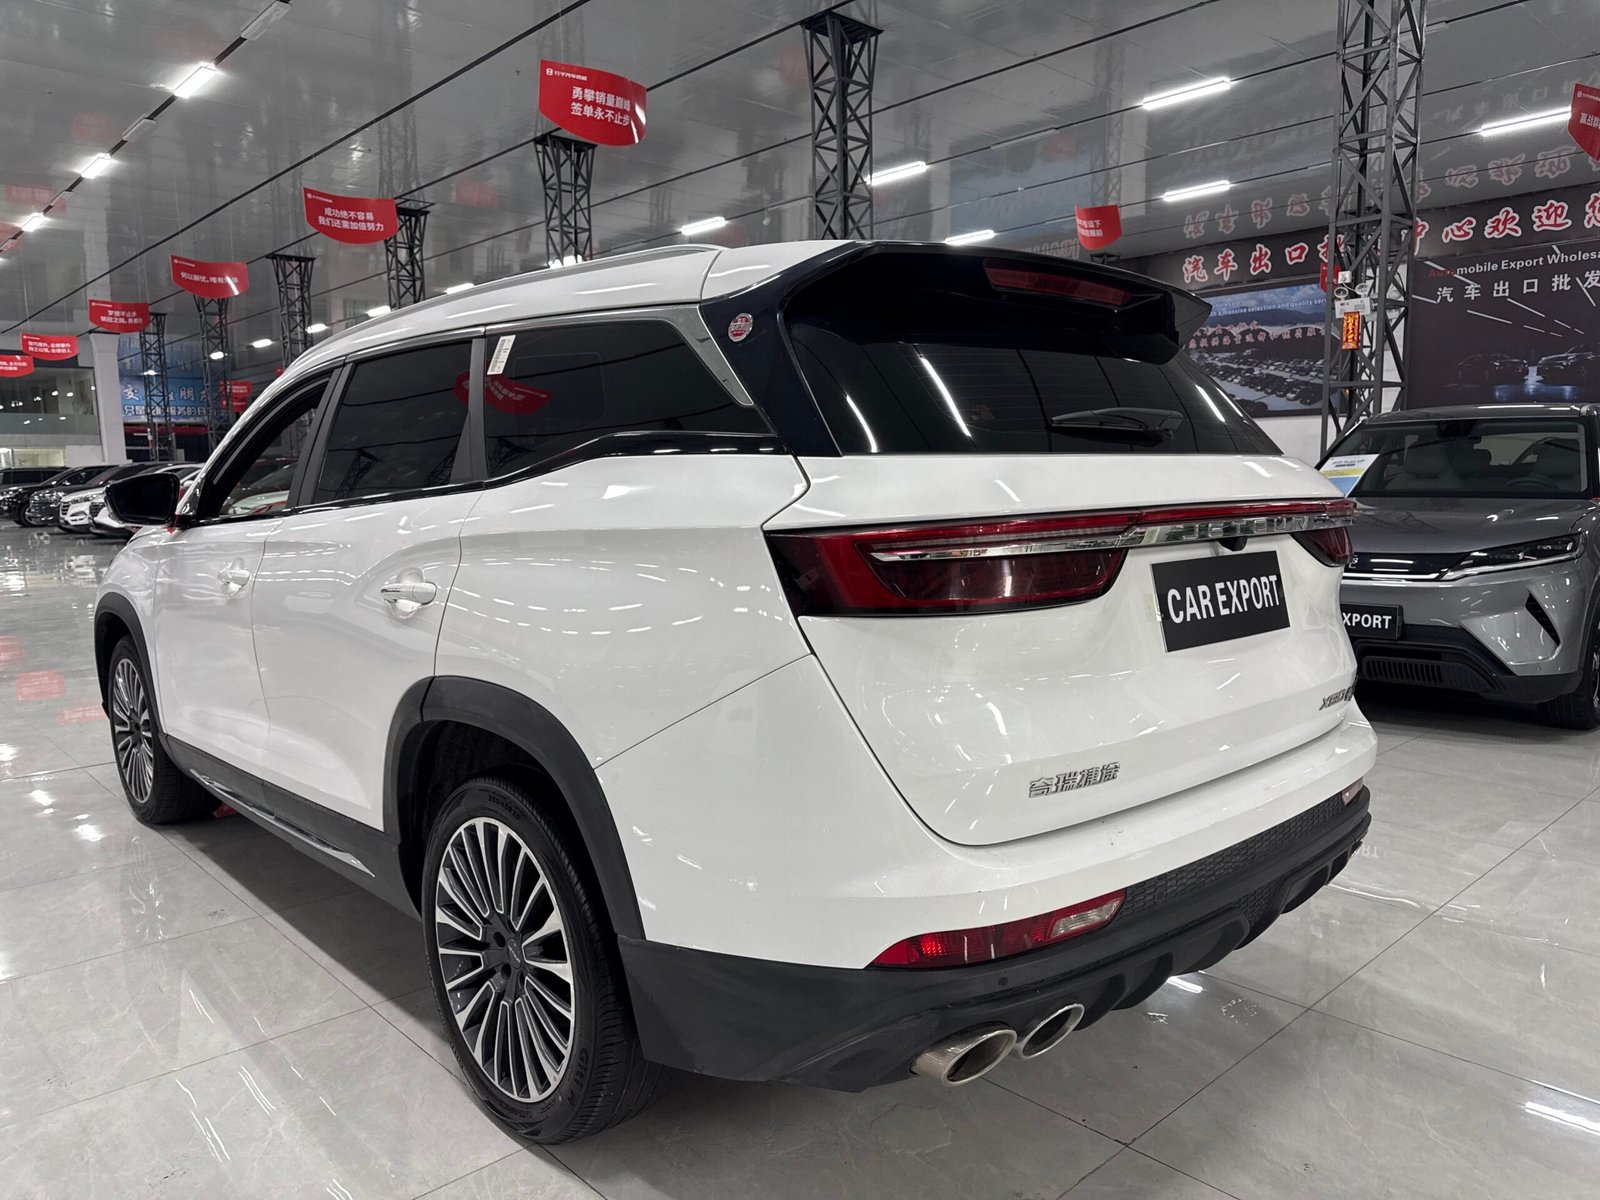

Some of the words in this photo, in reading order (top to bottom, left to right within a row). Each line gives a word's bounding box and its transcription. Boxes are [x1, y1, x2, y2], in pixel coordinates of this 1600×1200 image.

[570, 102, 630, 126] 签单永不止步
[1428, 262, 1498, 277] Automobile
[1501, 256, 1543, 271] Export
[1436, 270, 1600, 303] 汽车出口批发
[1182, 515, 1309, 540] JETOUR
[1167, 584, 1215, 624] CAR
[1215, 574, 1280, 616] EXPORT
[1342, 612, 1392, 629] XPORT
[1028, 762, 1121, 798] 奇瑞捷途
